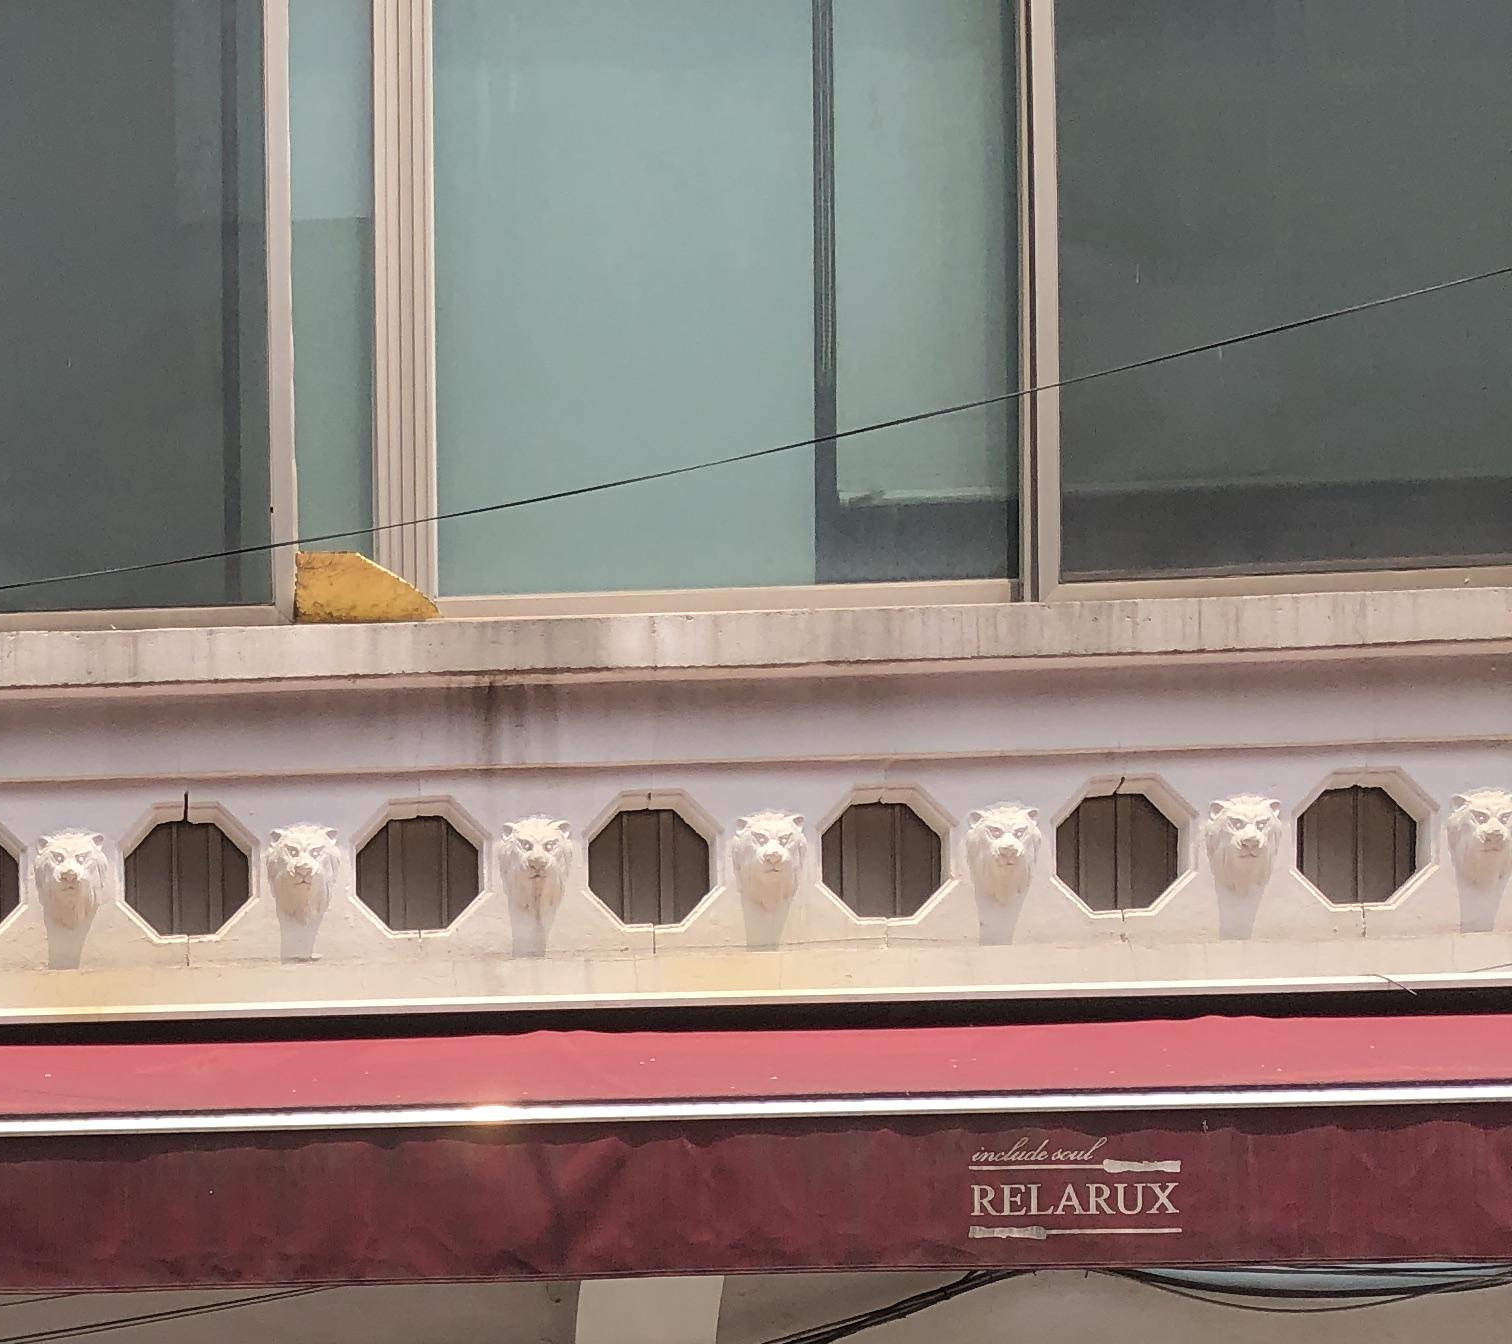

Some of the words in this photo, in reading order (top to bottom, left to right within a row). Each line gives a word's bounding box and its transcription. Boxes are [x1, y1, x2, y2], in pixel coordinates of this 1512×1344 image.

[972, 1136, 1050, 1163] include
[1051, 1136, 1108, 1162] soul
[970, 1182, 1180, 1216] RELARUX
